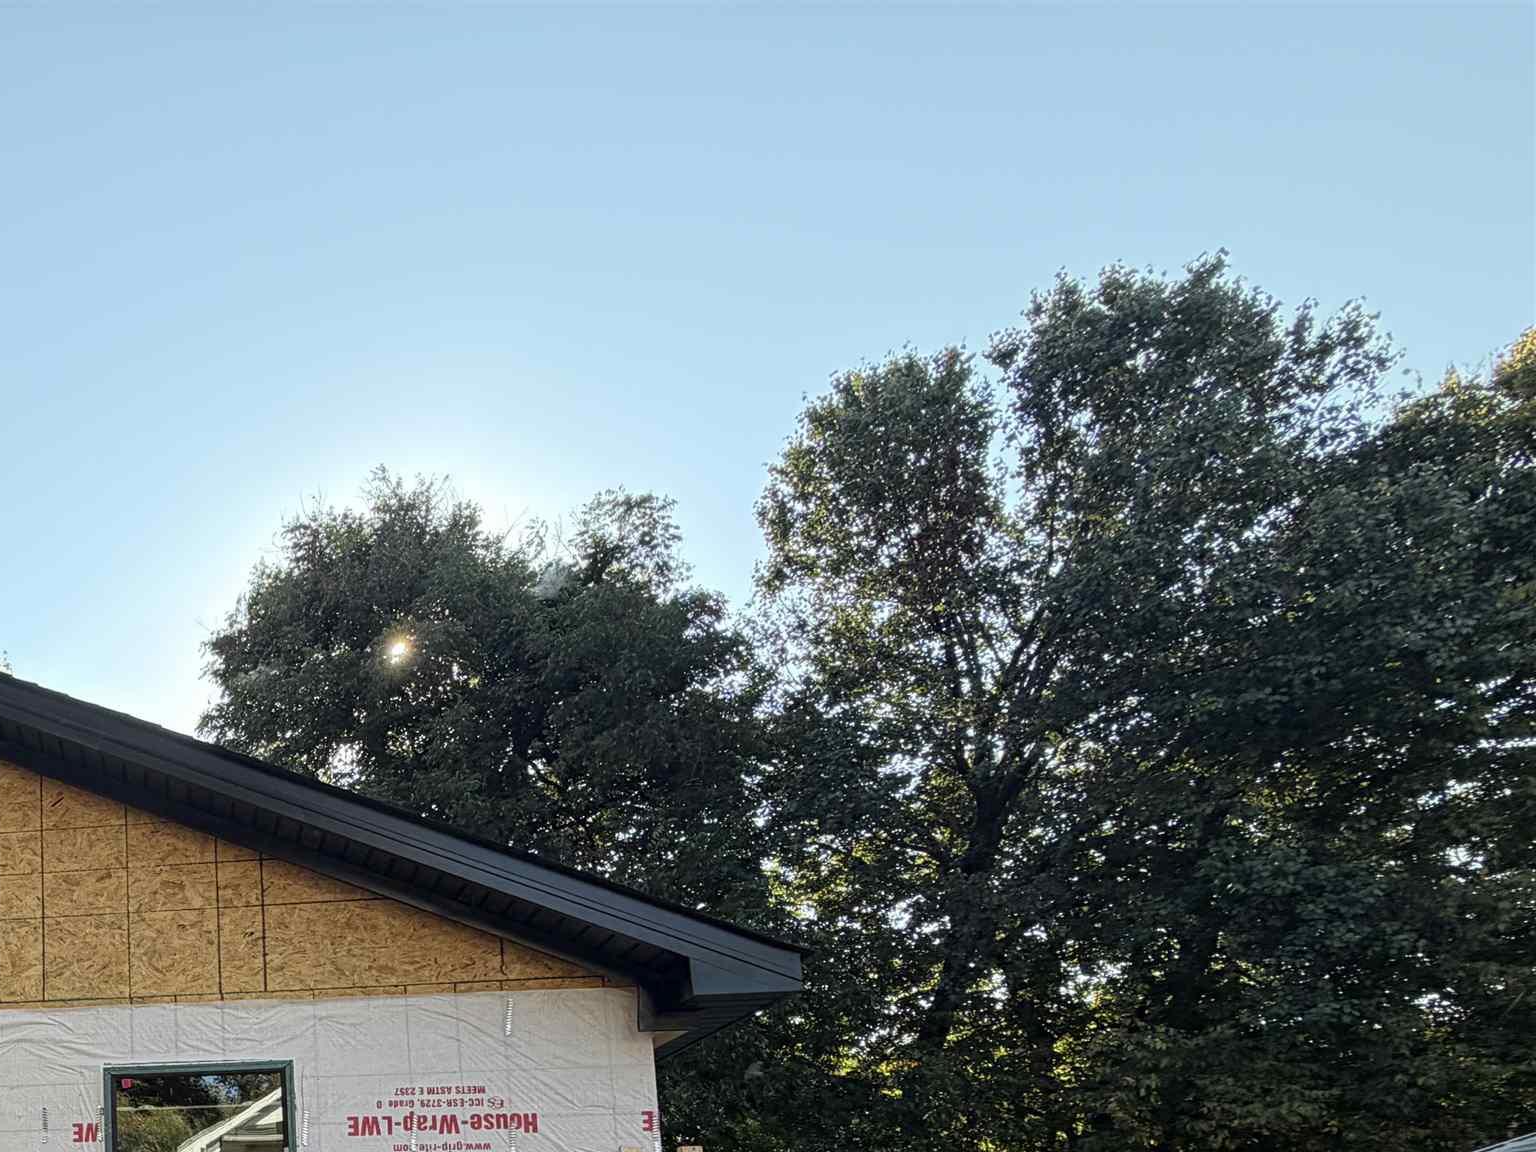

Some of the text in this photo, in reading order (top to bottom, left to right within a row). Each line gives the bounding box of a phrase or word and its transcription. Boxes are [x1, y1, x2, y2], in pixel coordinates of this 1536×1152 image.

[394, 1086, 486, 1096] MEETS ASTM E 2357
[388, 1099, 415, 1109] Grade
[346, 1111, 538, 1136] House-Wrap-LWE
